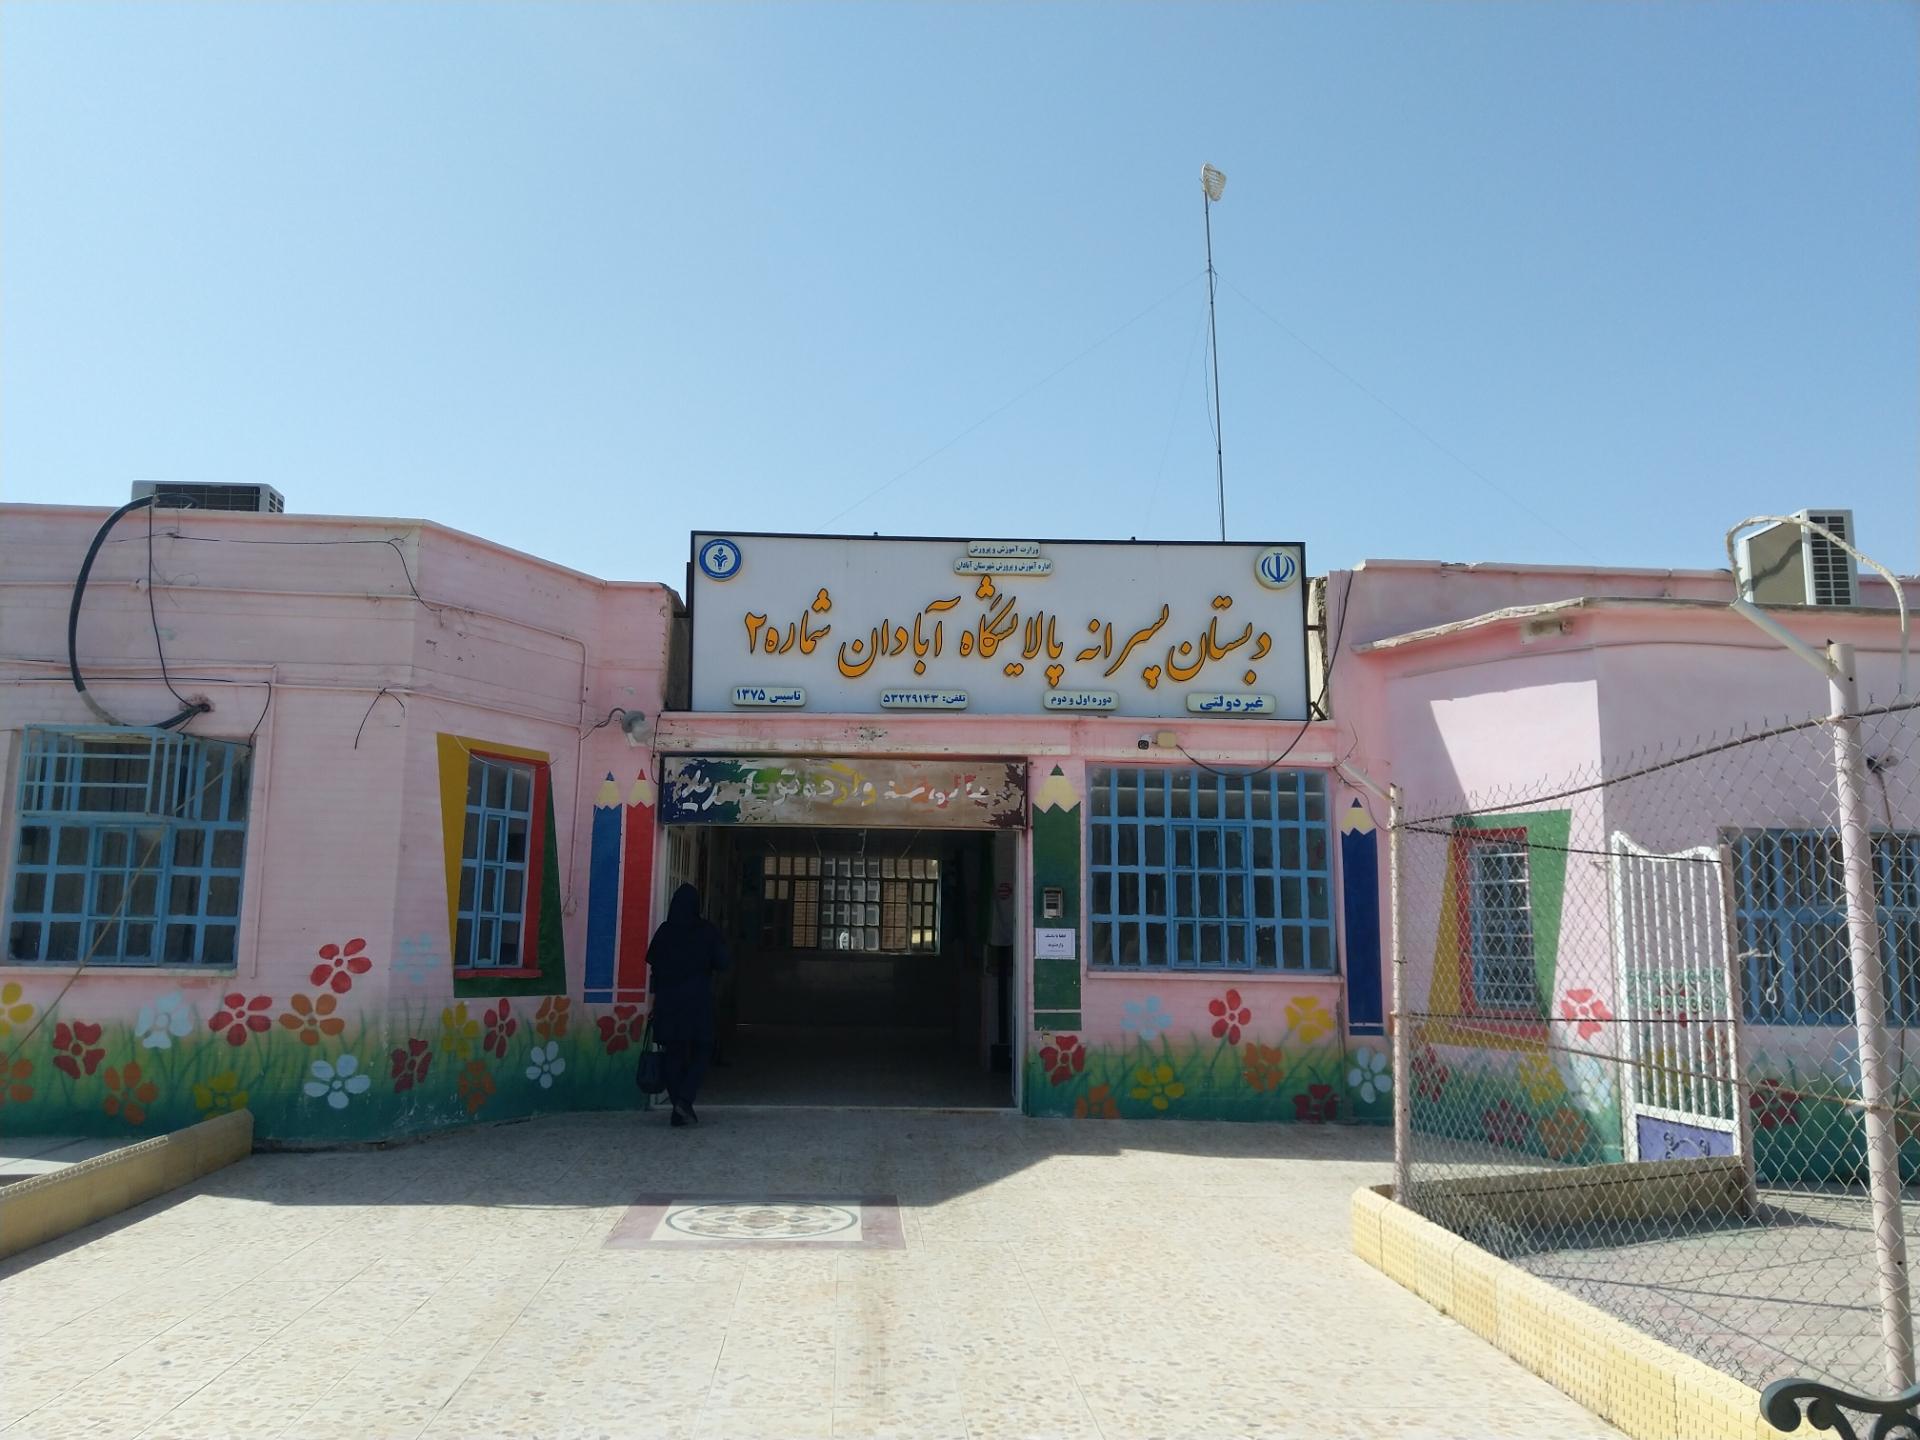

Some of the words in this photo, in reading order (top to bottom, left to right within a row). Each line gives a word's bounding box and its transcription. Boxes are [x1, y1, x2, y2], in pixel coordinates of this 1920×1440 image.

[970, 545, 991, 553] پرورش
[997, 545, 1018, 554] آموزش
[1020, 546, 1038, 554] وزارت
[956, 561, 972, 569] آبادان
[973, 561, 994, 571] شهرستان
[995, 561, 1014, 572] پرورش
[1018, 561, 1036, 572] آموزش
[1037, 563, 1050, 571] اداره
[960, 574, 1064, 688] پالایشگاه
[837, 595, 962, 679] آبادان
[1166, 594, 1273, 685] دبستان
[1075, 603, 1170, 689] پسرانه
[736, 688, 766, 701] ۱۳۷۵
[769, 689, 802, 704] تاسیس
[942, 694, 966, 704] تلفن:
[1075, 694, 1091, 705] اول
[1050, 695, 1068, 705] دوم
[1092, 697, 1112, 706] دوره
